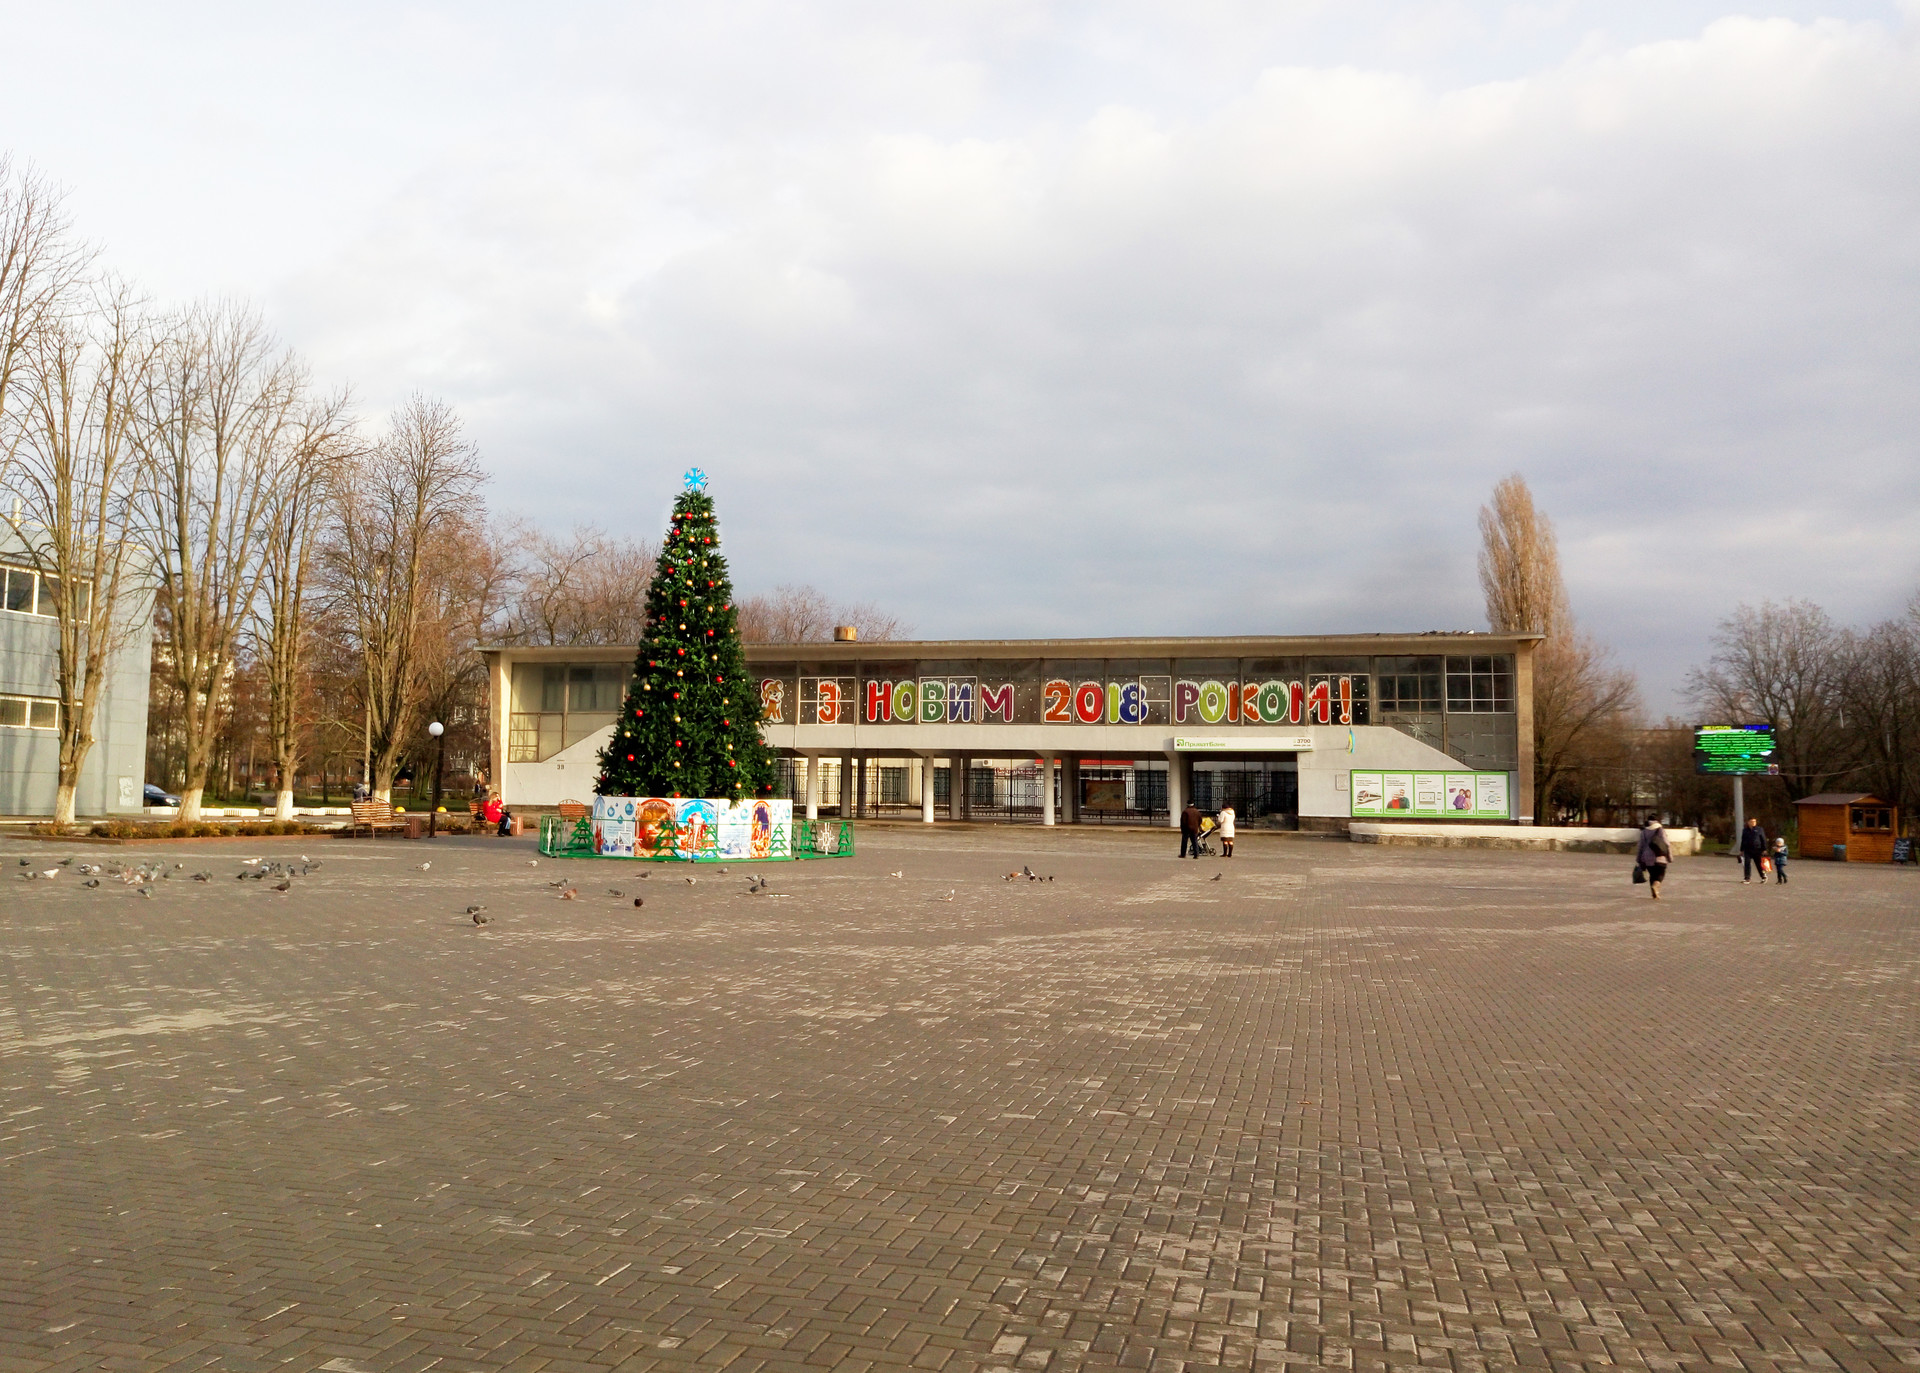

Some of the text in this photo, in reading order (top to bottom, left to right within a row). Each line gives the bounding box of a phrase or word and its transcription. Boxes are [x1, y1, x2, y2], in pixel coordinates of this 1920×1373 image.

[866, 680, 1014, 722] НОВИМ
[1044, 679, 1149, 723] 2018
[1175, 676, 1351, 724] РОКОМ!
